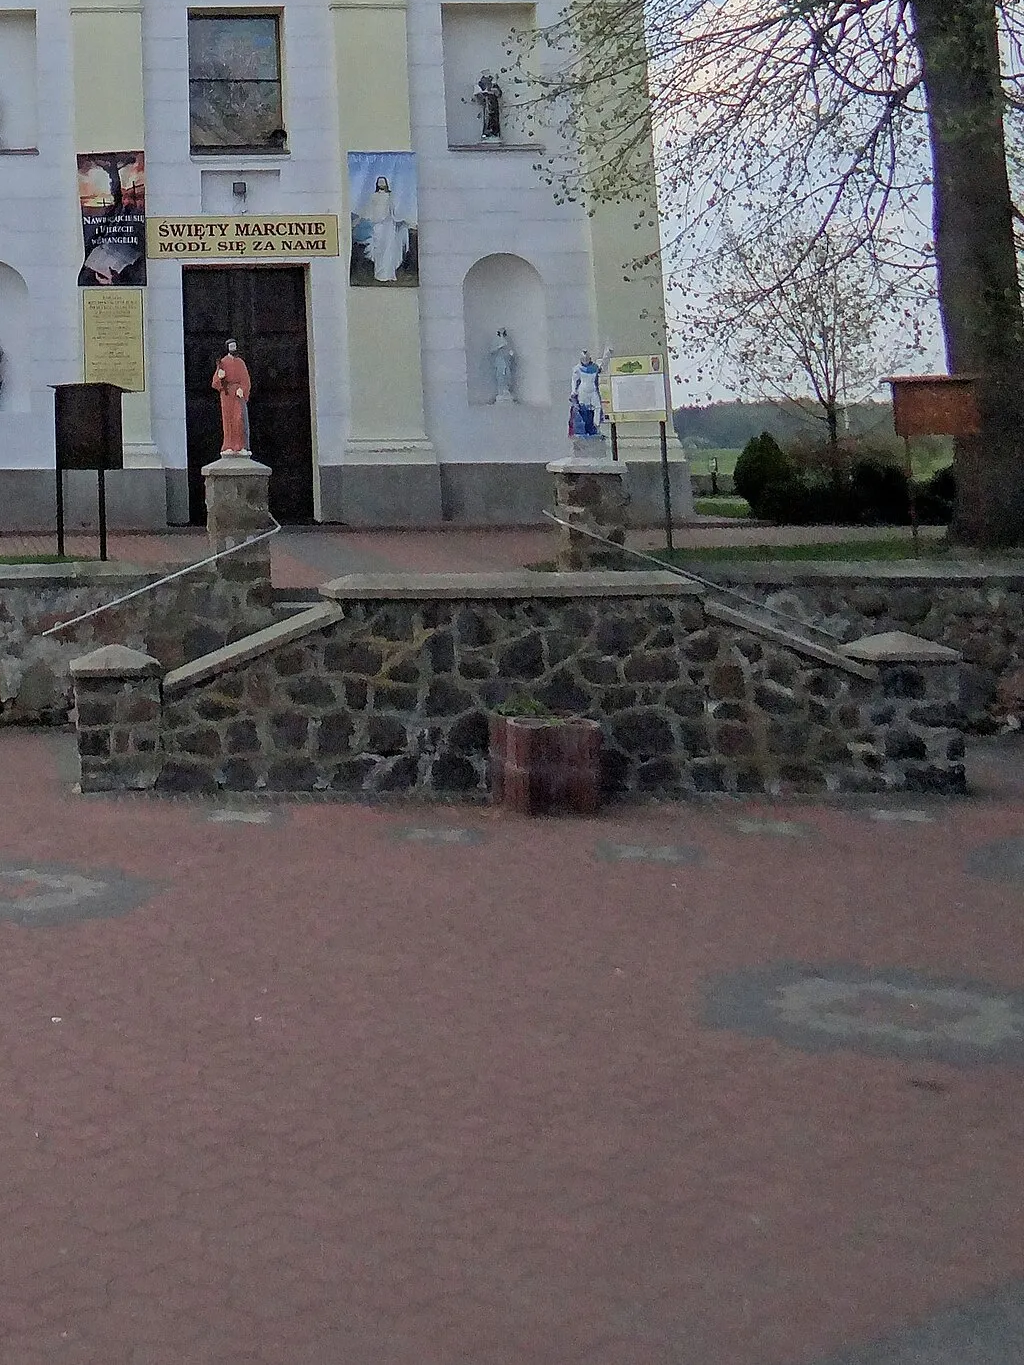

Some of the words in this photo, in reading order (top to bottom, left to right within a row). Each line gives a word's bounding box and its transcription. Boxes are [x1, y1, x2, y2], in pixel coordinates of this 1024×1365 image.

[83, 215, 132, 224] NAWRCAJCIE
[158, 220, 229, 240] ŚWIĘTY
[235, 222, 326, 236] MARCINIE
[158, 239, 212, 252] MÓDL
[217, 241, 246, 254] SIĘ
[252, 240, 276, 250] ZA
[281, 239, 326, 250] NAMI
